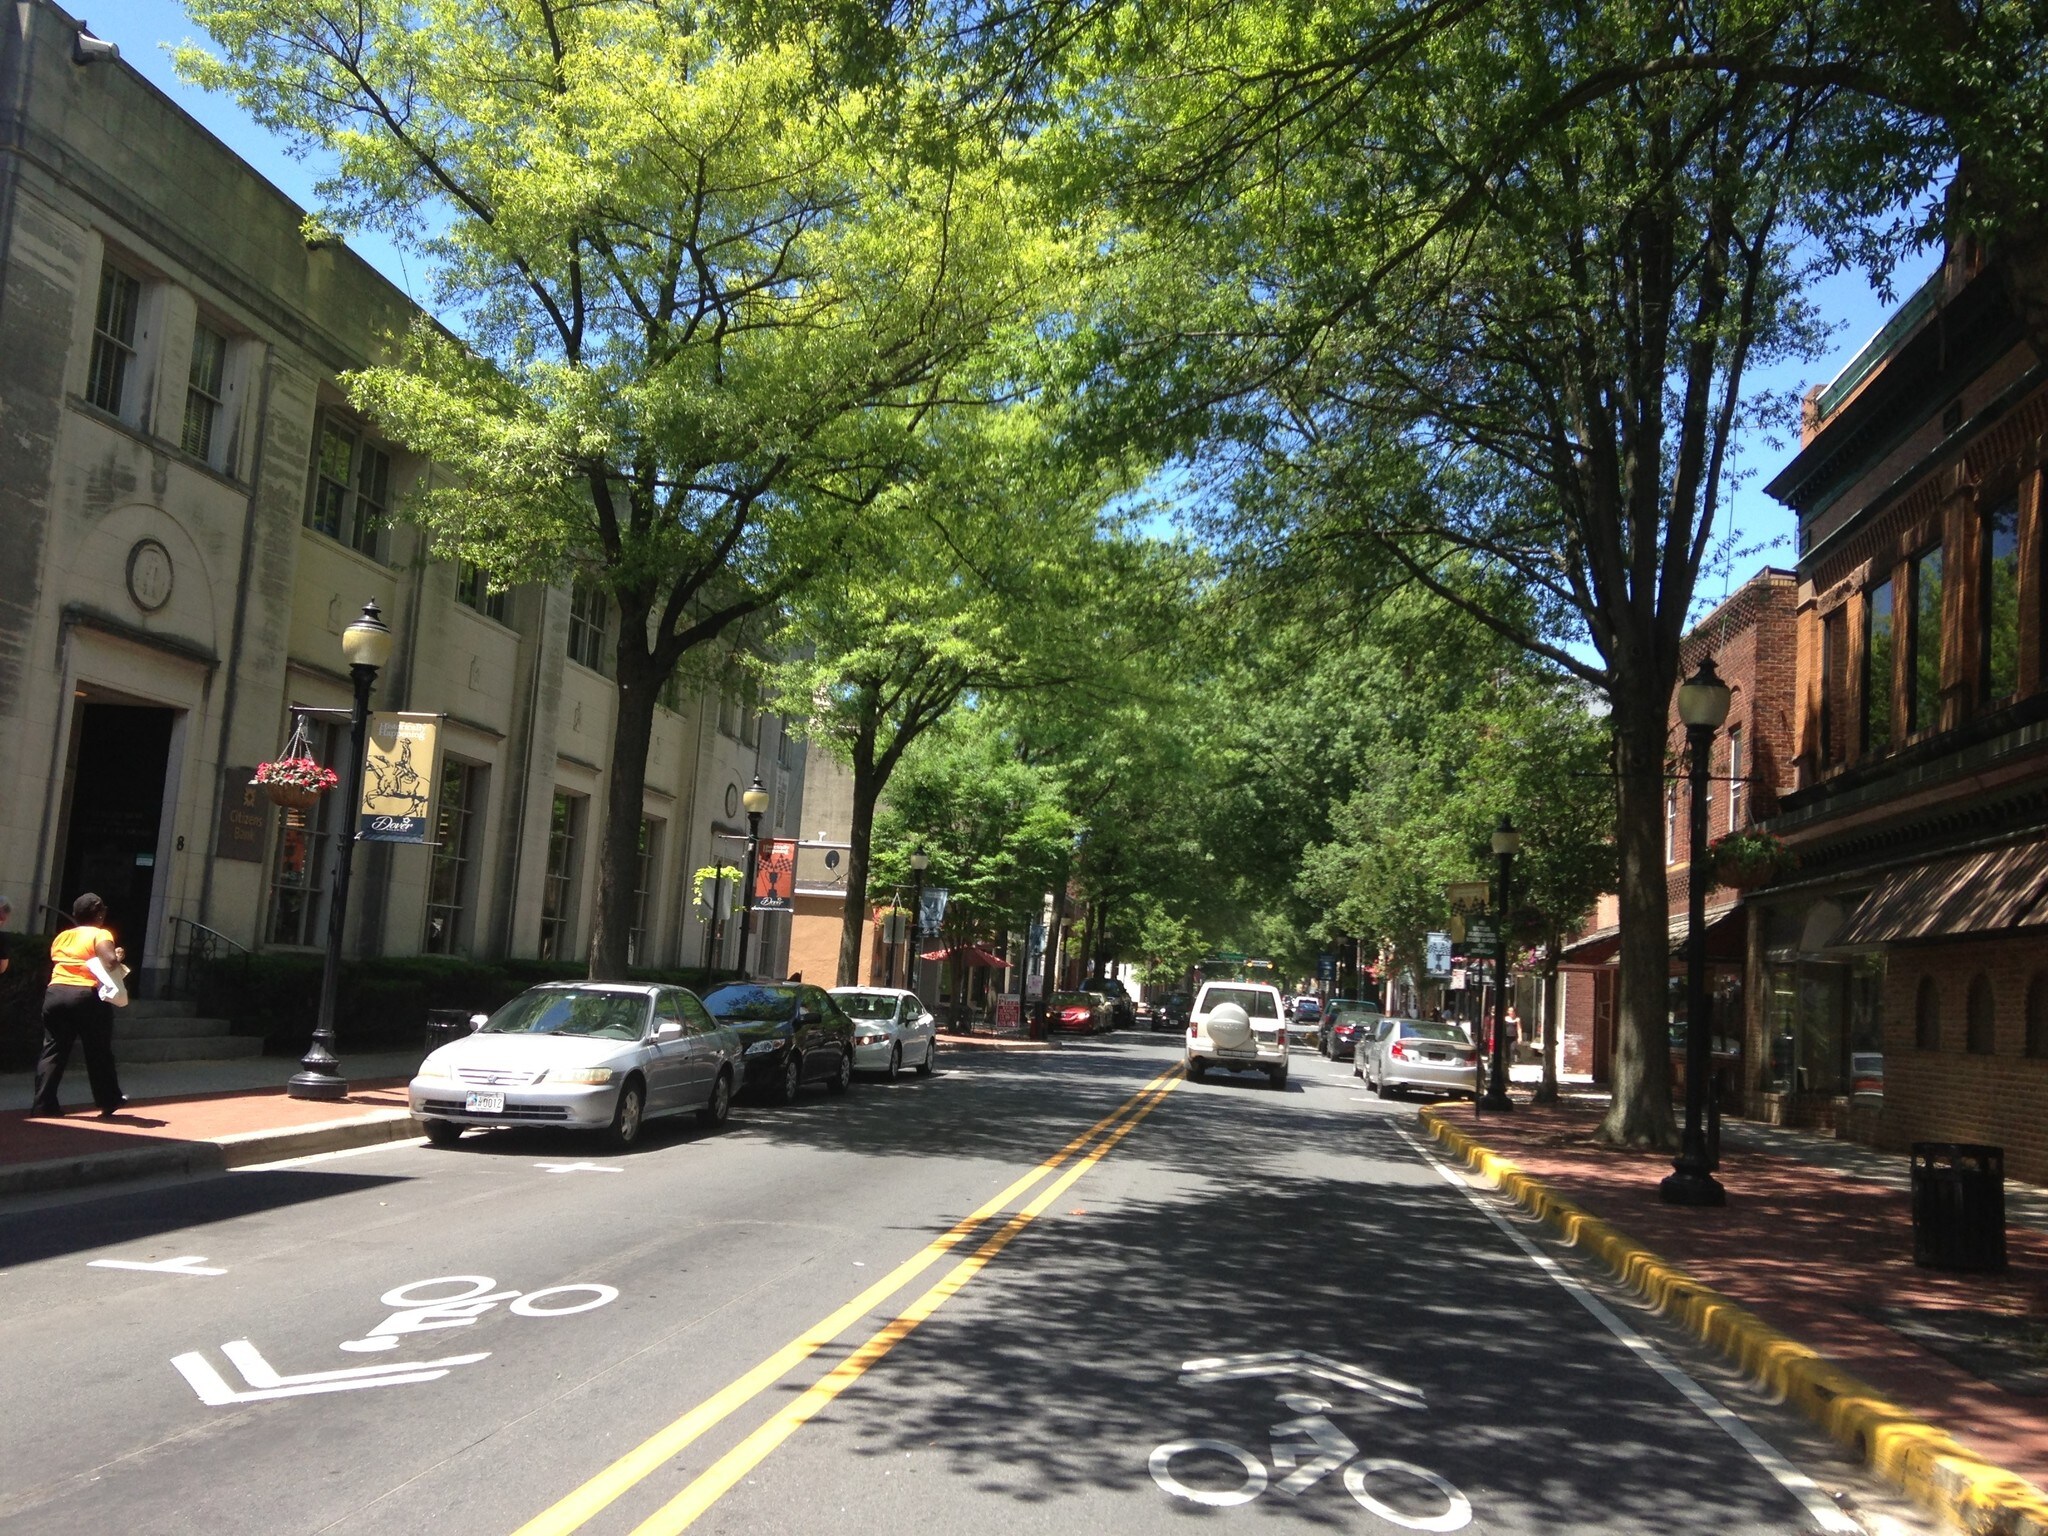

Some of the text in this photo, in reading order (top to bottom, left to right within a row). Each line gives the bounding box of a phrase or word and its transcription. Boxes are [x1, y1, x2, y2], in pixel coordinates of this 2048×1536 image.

[379, 728, 425, 741] Happening
[380, 722, 424, 732] Historically
[230, 809, 263, 828] Citizens
[371, 815, 413, 830] Dover
[177, 836, 185, 851] 8
